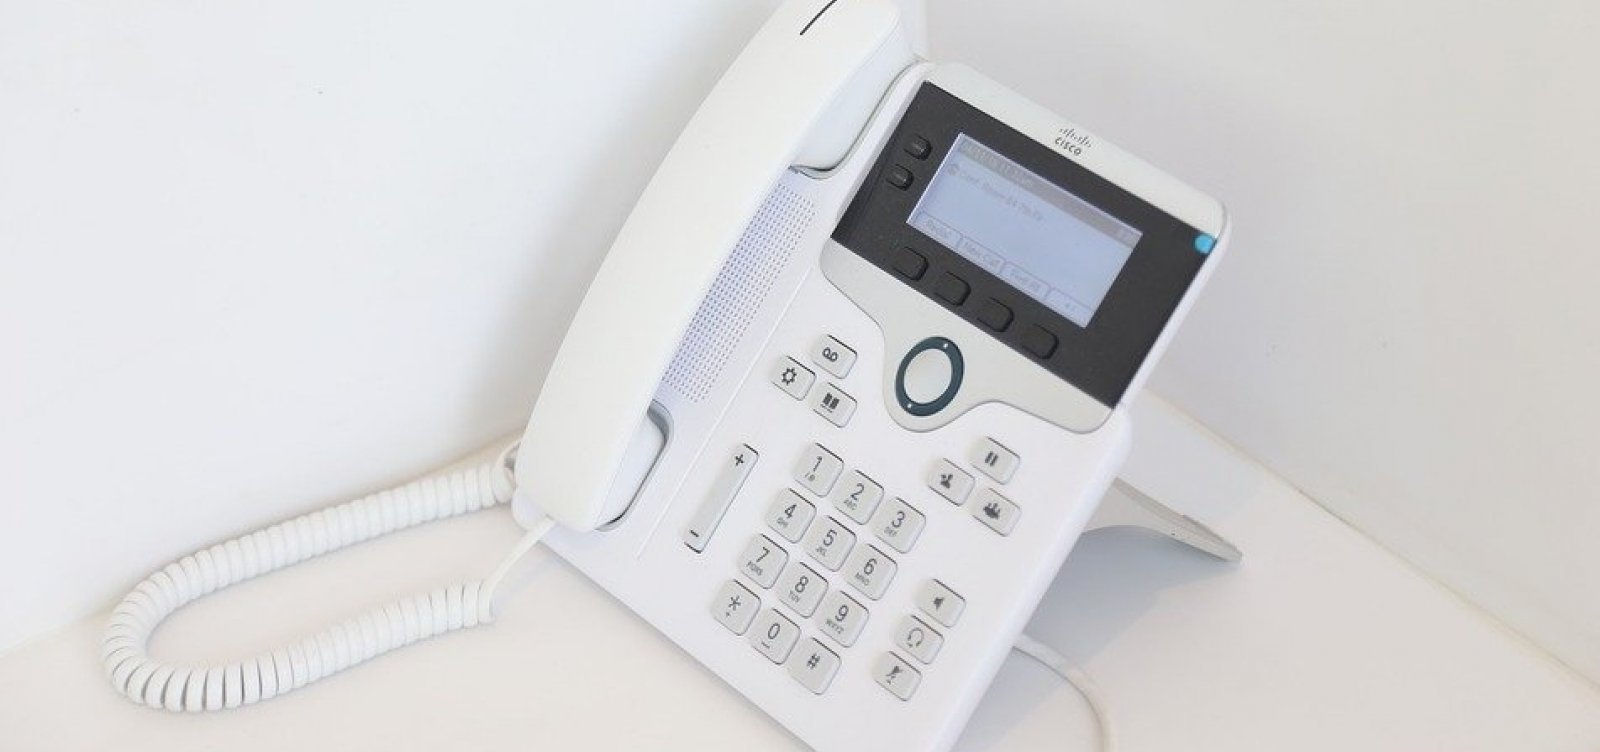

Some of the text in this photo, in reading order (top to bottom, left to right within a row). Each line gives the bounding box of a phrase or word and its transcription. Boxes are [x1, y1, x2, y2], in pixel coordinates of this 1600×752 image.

[811, 456, 823, 472] 1
[849, 483, 865, 500] 2
[784, 504, 796, 519] 4
[891, 511, 905, 528] 3
[822, 530, 837, 546] 5
[758, 547, 770, 563] 7
[862, 558, 877, 575] 6
[794, 576, 810, 593] 8
[834, 605, 849, 622] 9
[767, 623, 780, 640] 0
[807, 653, 820, 669] #
